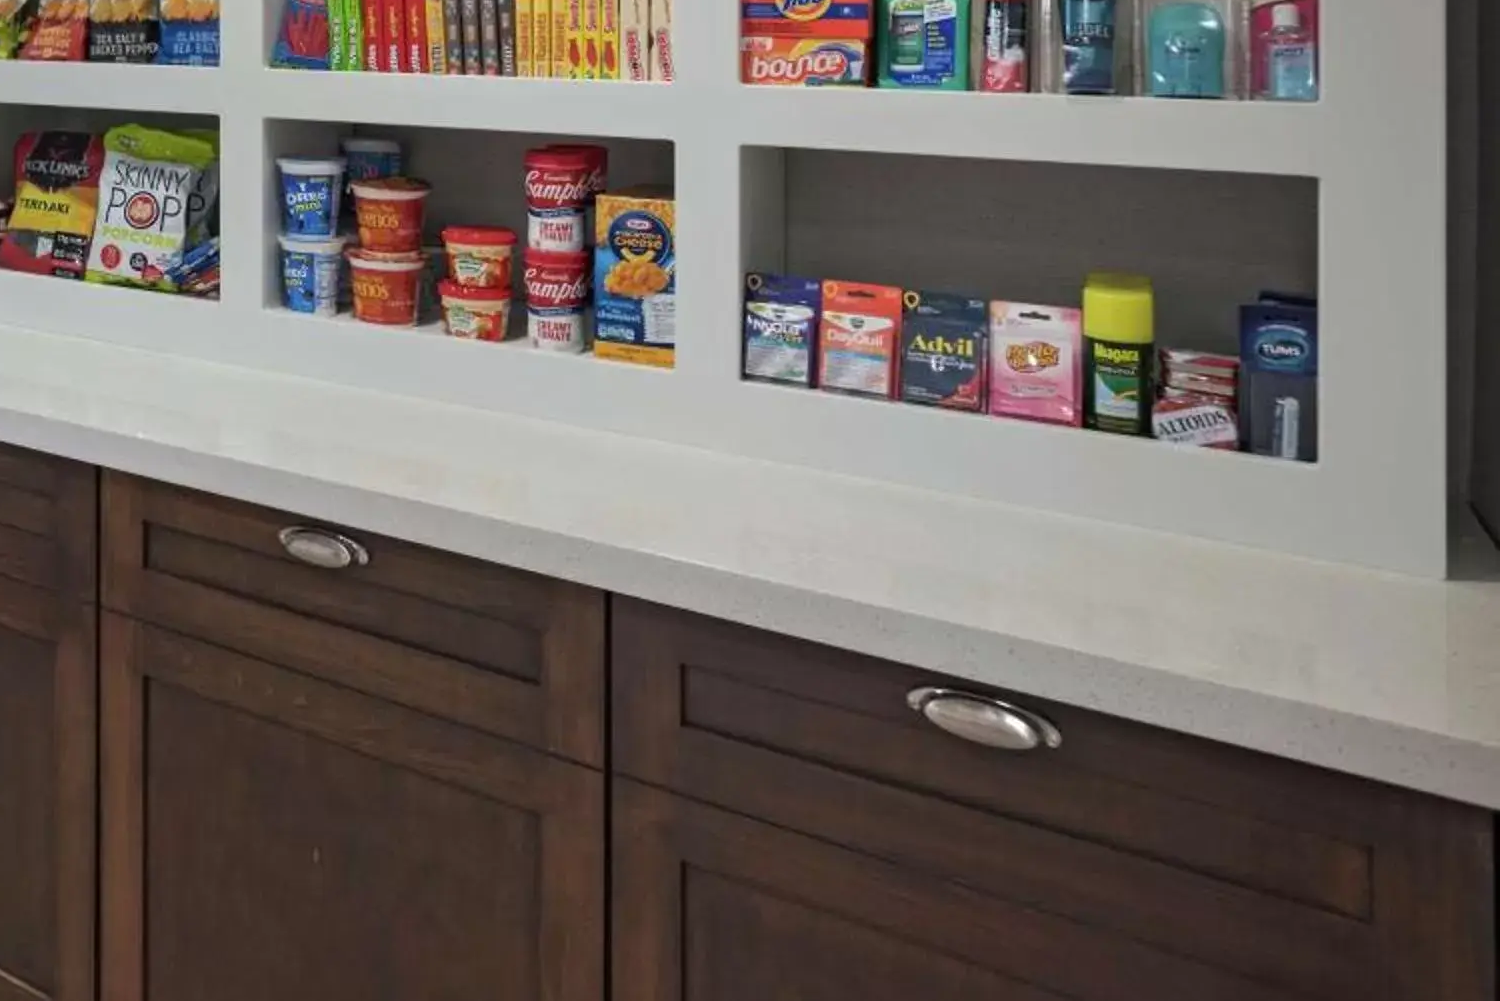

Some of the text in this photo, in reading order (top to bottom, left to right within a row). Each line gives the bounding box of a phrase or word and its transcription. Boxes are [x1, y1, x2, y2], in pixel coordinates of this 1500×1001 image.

[751, 50, 842, 80] bounce
[115, 159, 189, 194] SKINNY
[20, 198, 70, 215] TERIYAKI
[105, 186, 182, 232] POP
[102, 225, 178, 248] POPCORN
[909, 333, 975, 357] Advil
[1156, 410, 1227, 436] ALTOIDS
